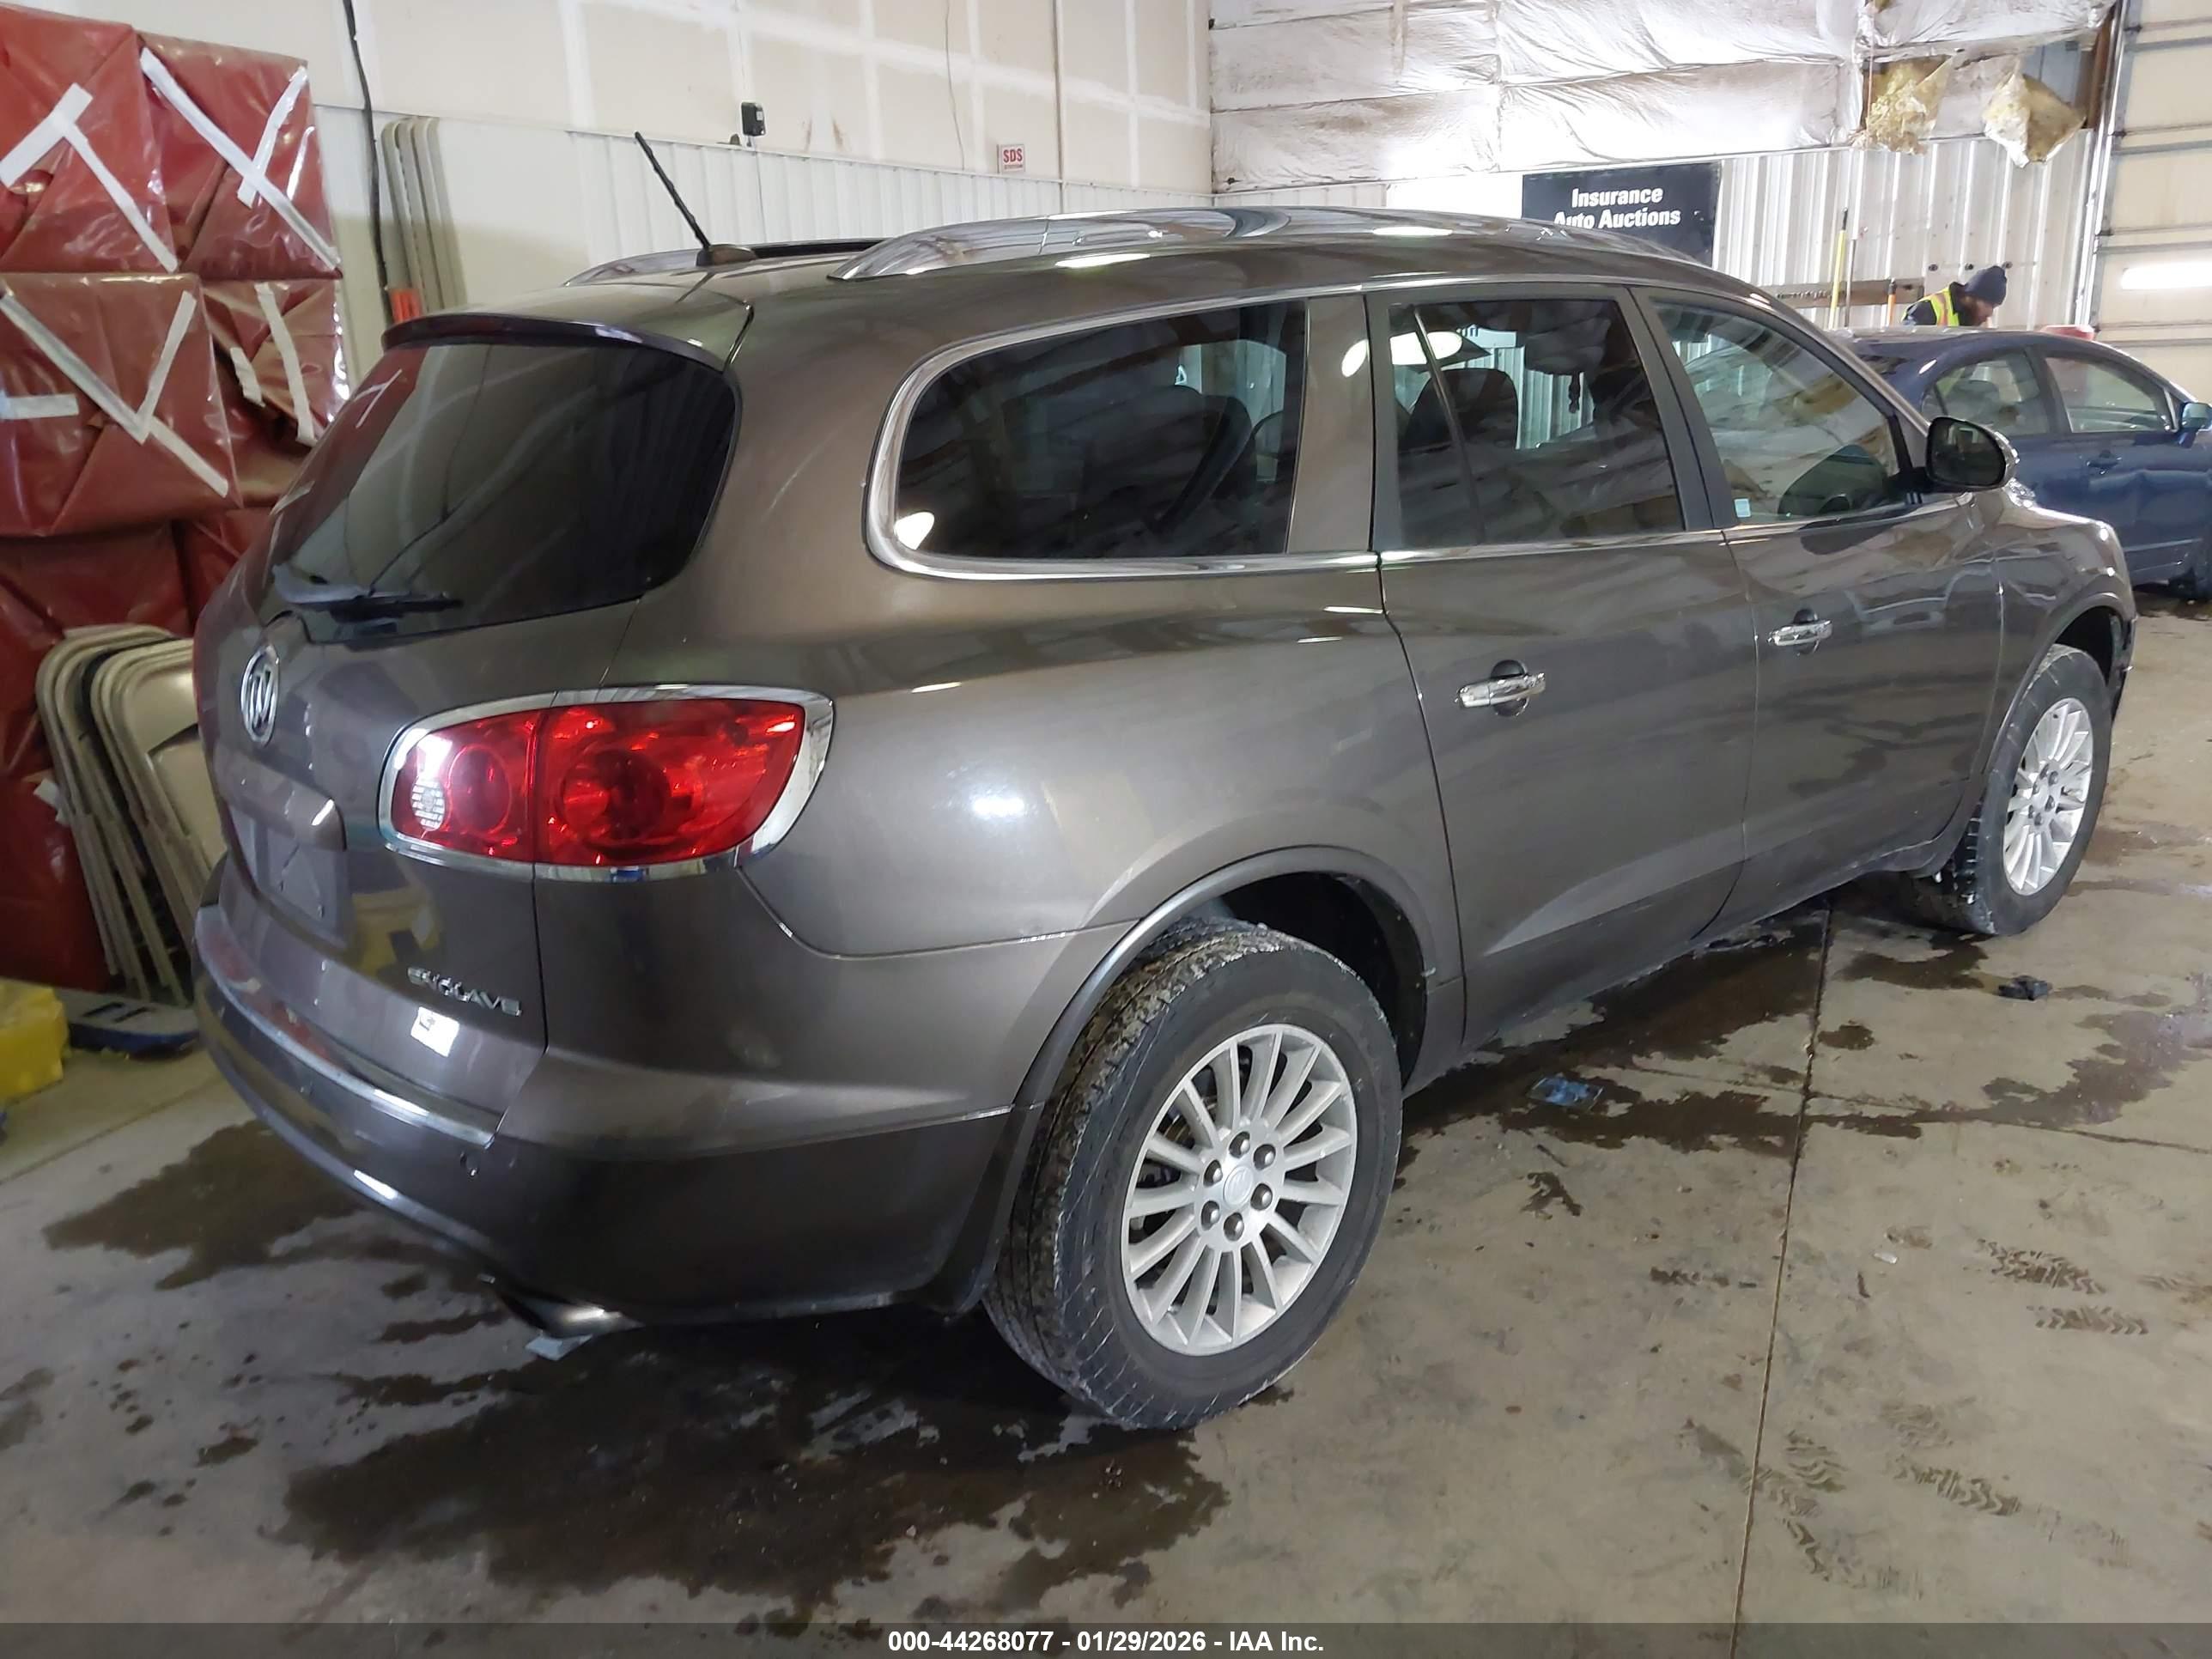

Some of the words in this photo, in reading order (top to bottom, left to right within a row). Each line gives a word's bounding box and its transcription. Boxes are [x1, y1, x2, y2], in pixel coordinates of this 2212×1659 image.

[1003, 148, 1023, 163] SDS
[1571, 187, 1663, 209] Insurance
[1597, 207, 1681, 229] Auctions
